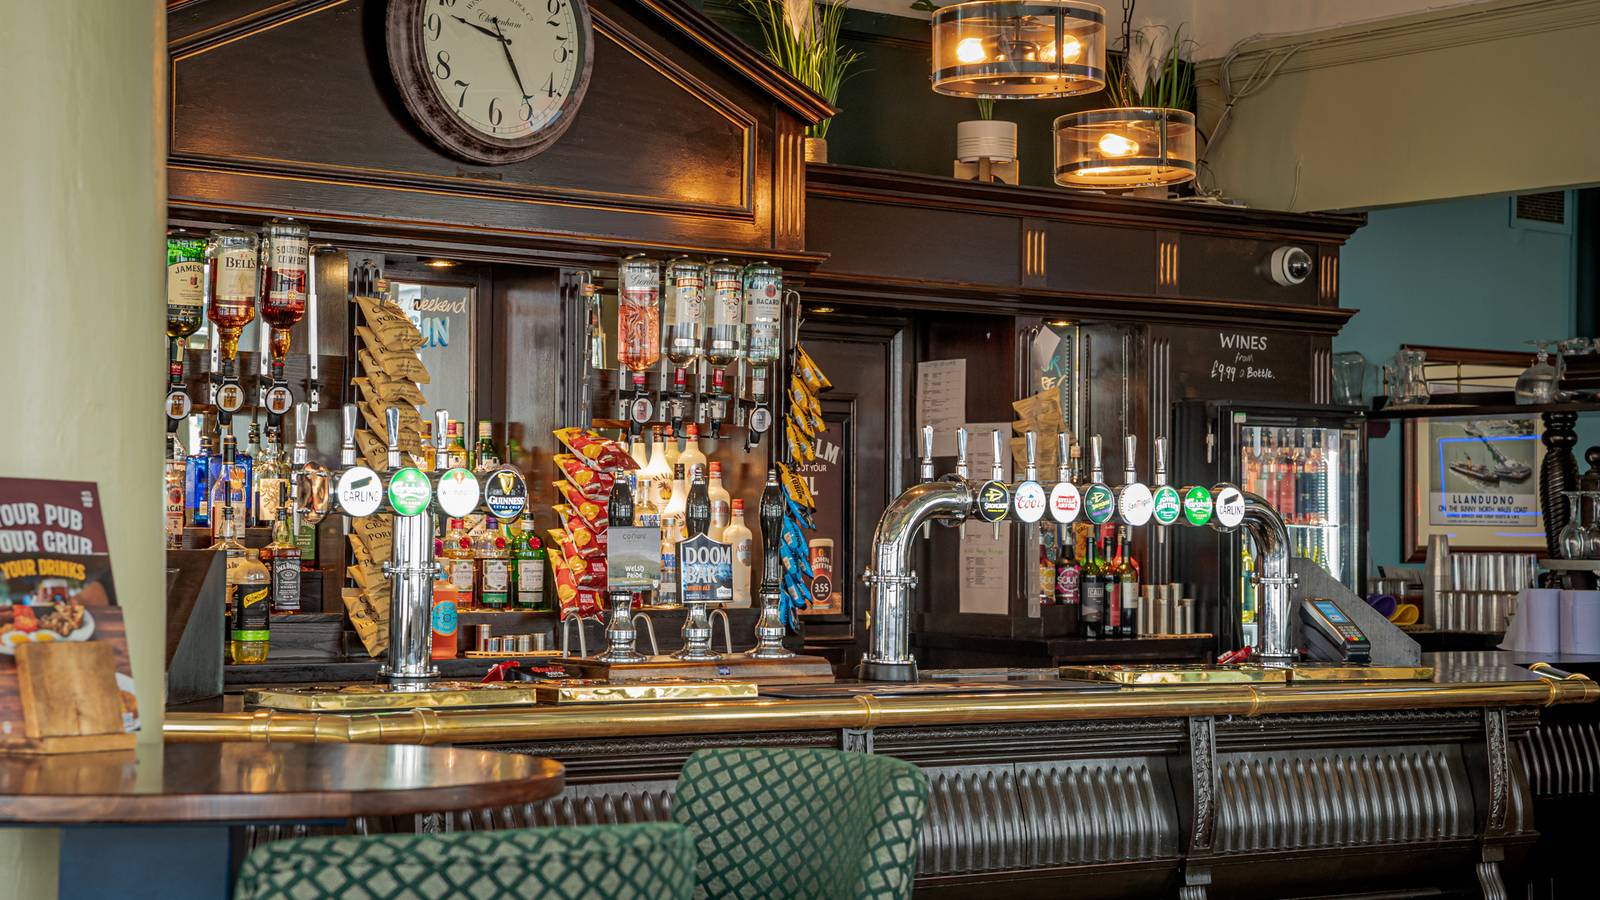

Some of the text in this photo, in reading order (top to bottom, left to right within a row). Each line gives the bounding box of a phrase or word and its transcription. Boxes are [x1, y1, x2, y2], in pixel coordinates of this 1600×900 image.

[427, 13, 442, 41] 9
[478, 9, 521, 29] Cheenham
[552, 35, 568, 63] 3
[435, 50, 450, 80] 8
[454, 79, 470, 108] 7
[540, 72, 557, 98] 4
[488, 97, 502, 127] 6
[1220, 332, 1268, 351] WINES
[1235, 352, 1254, 364] from
[1211, 360, 1236, 382] £9.99
[814, 439, 840, 465] LM
[810, 463, 828, 472] YOUR
[343, 490, 380, 502] CARLING
[488, 496, 525, 505] GUINNESS
[1453, 495, 1514, 505] LLANDUDNO
[0, 502, 83, 532] OUR PUB
[0, 530, 93, 555] OUR GRUB
[686, 547, 731, 565] DOOM
[0, 558, 86, 581] YOUR DRINKS
[687, 566, 718, 584] BAR
[815, 583, 830, 593] 3.55
